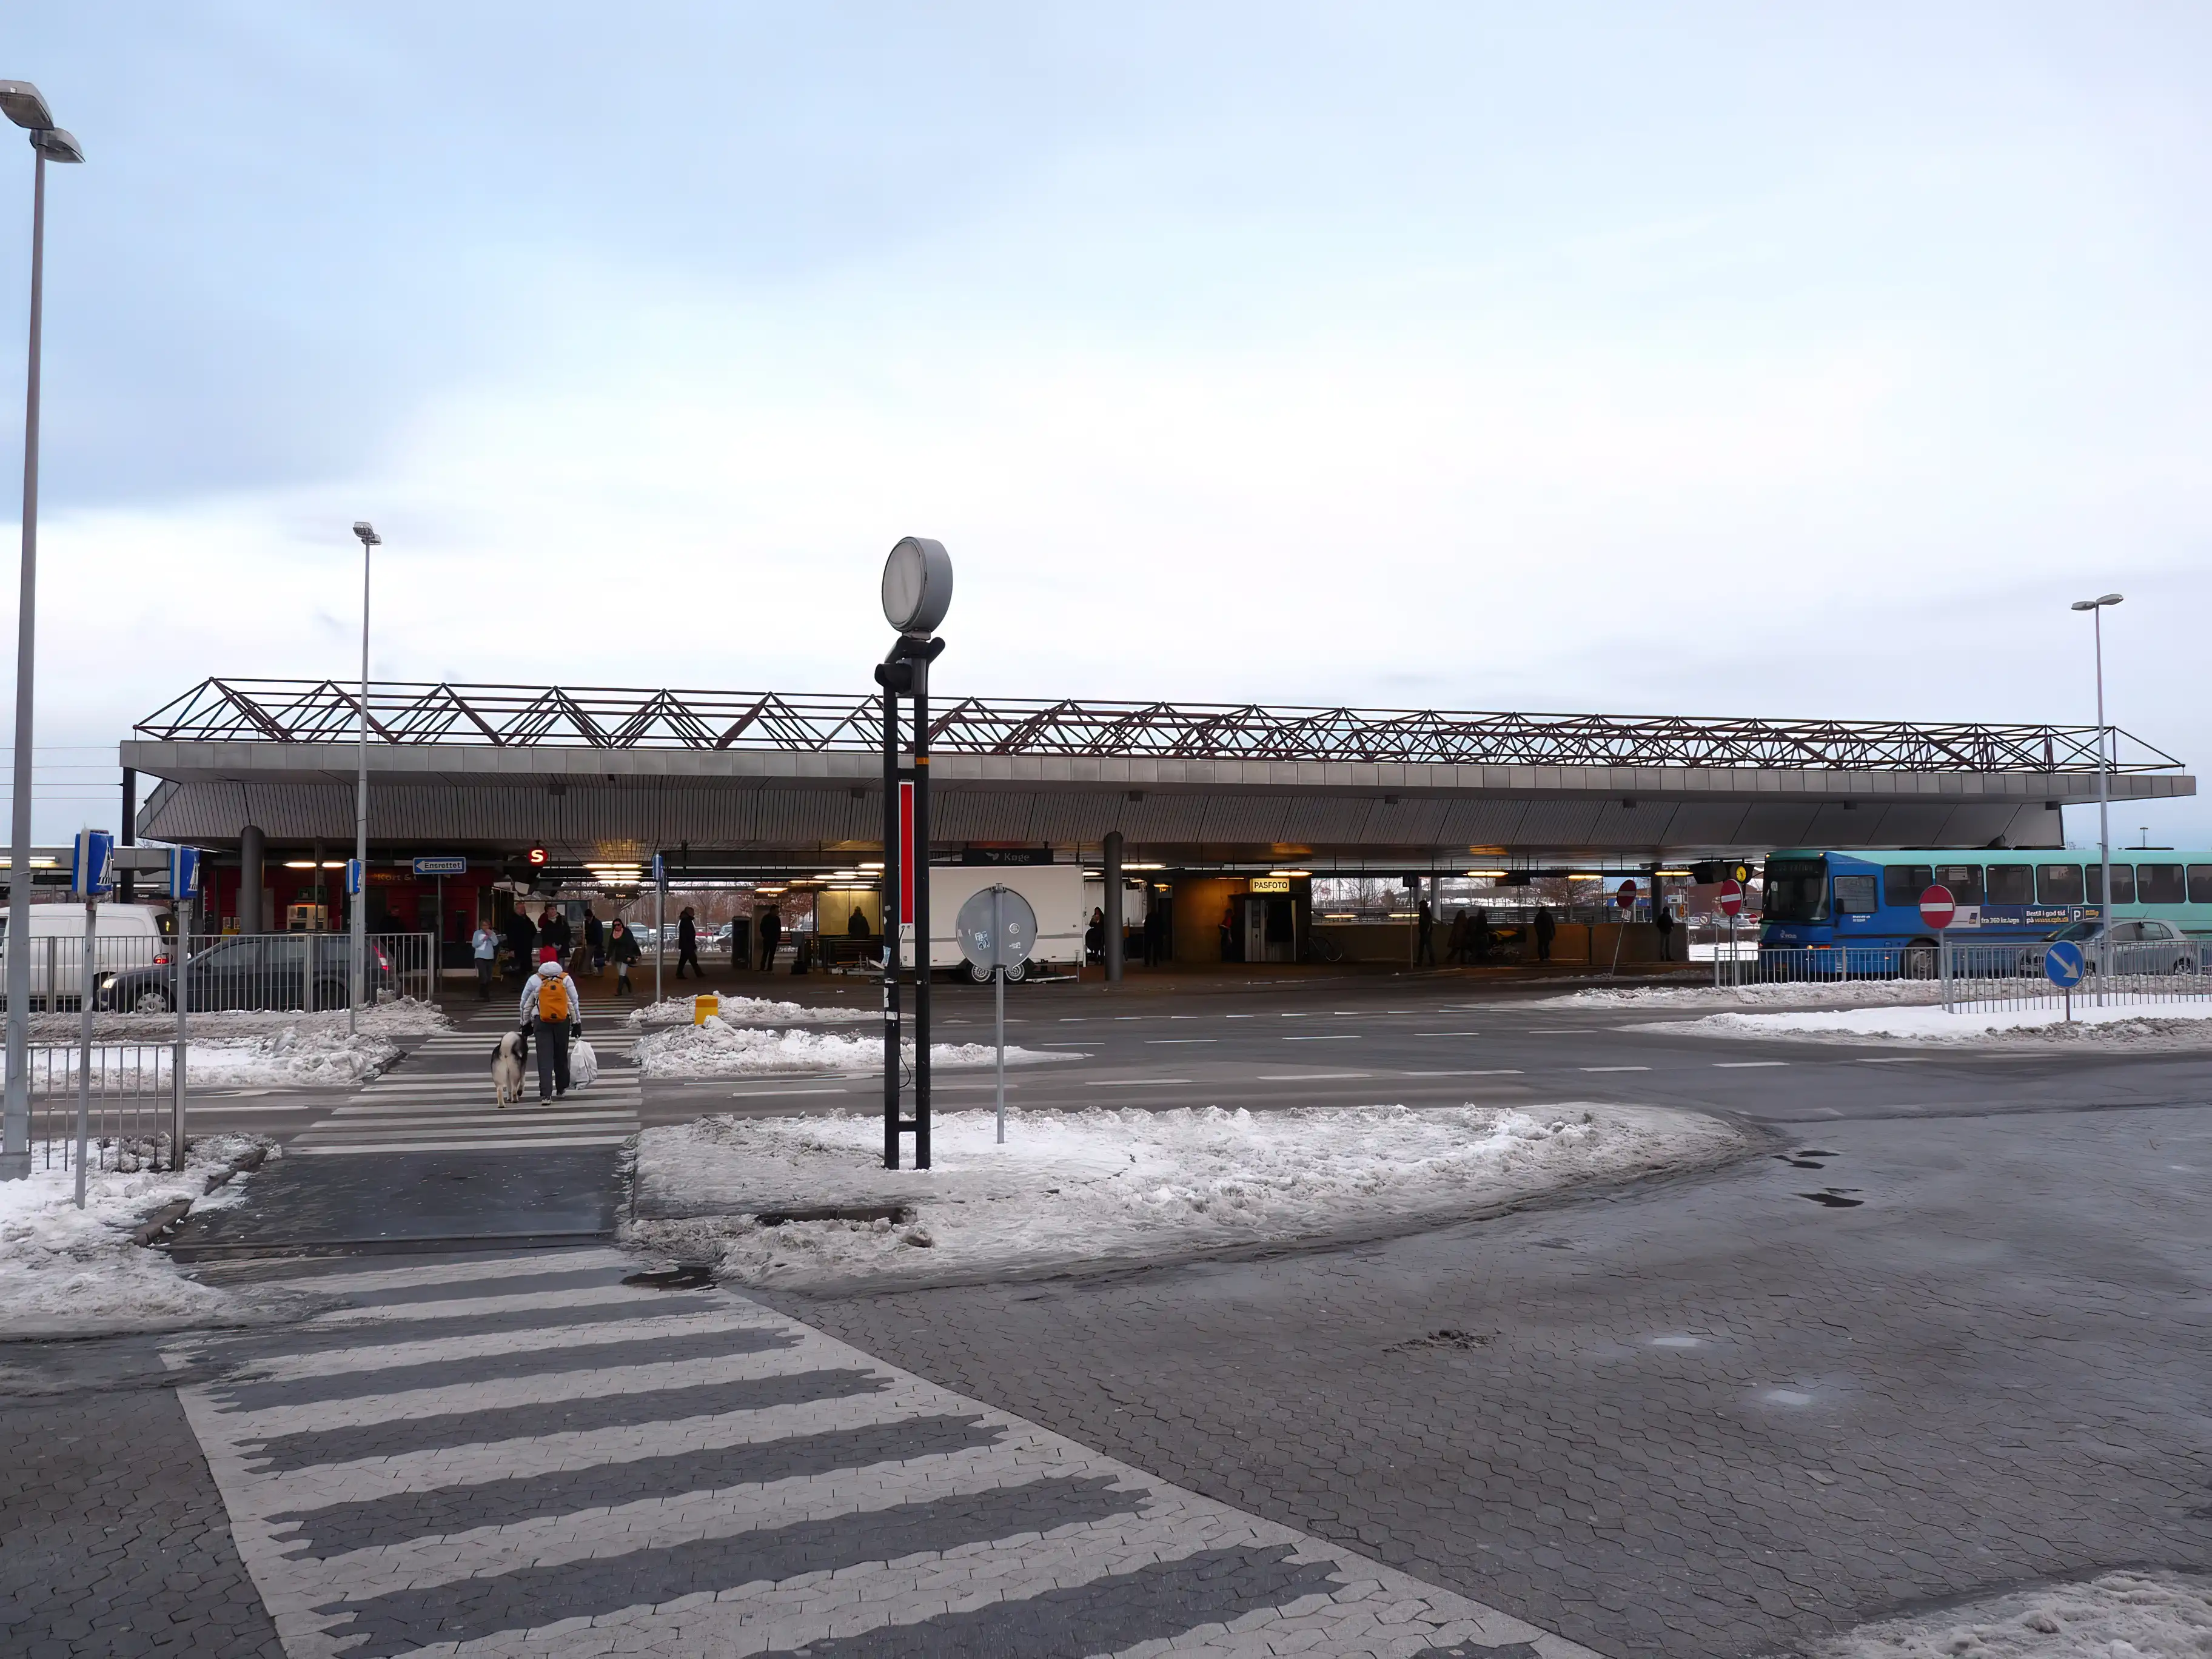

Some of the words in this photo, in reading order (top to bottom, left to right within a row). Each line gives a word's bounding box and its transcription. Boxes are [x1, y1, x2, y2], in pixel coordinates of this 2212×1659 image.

[531, 850, 544, 862] S
[1004, 853, 1030, 862] Køge
[2074, 910, 2080, 922] P
